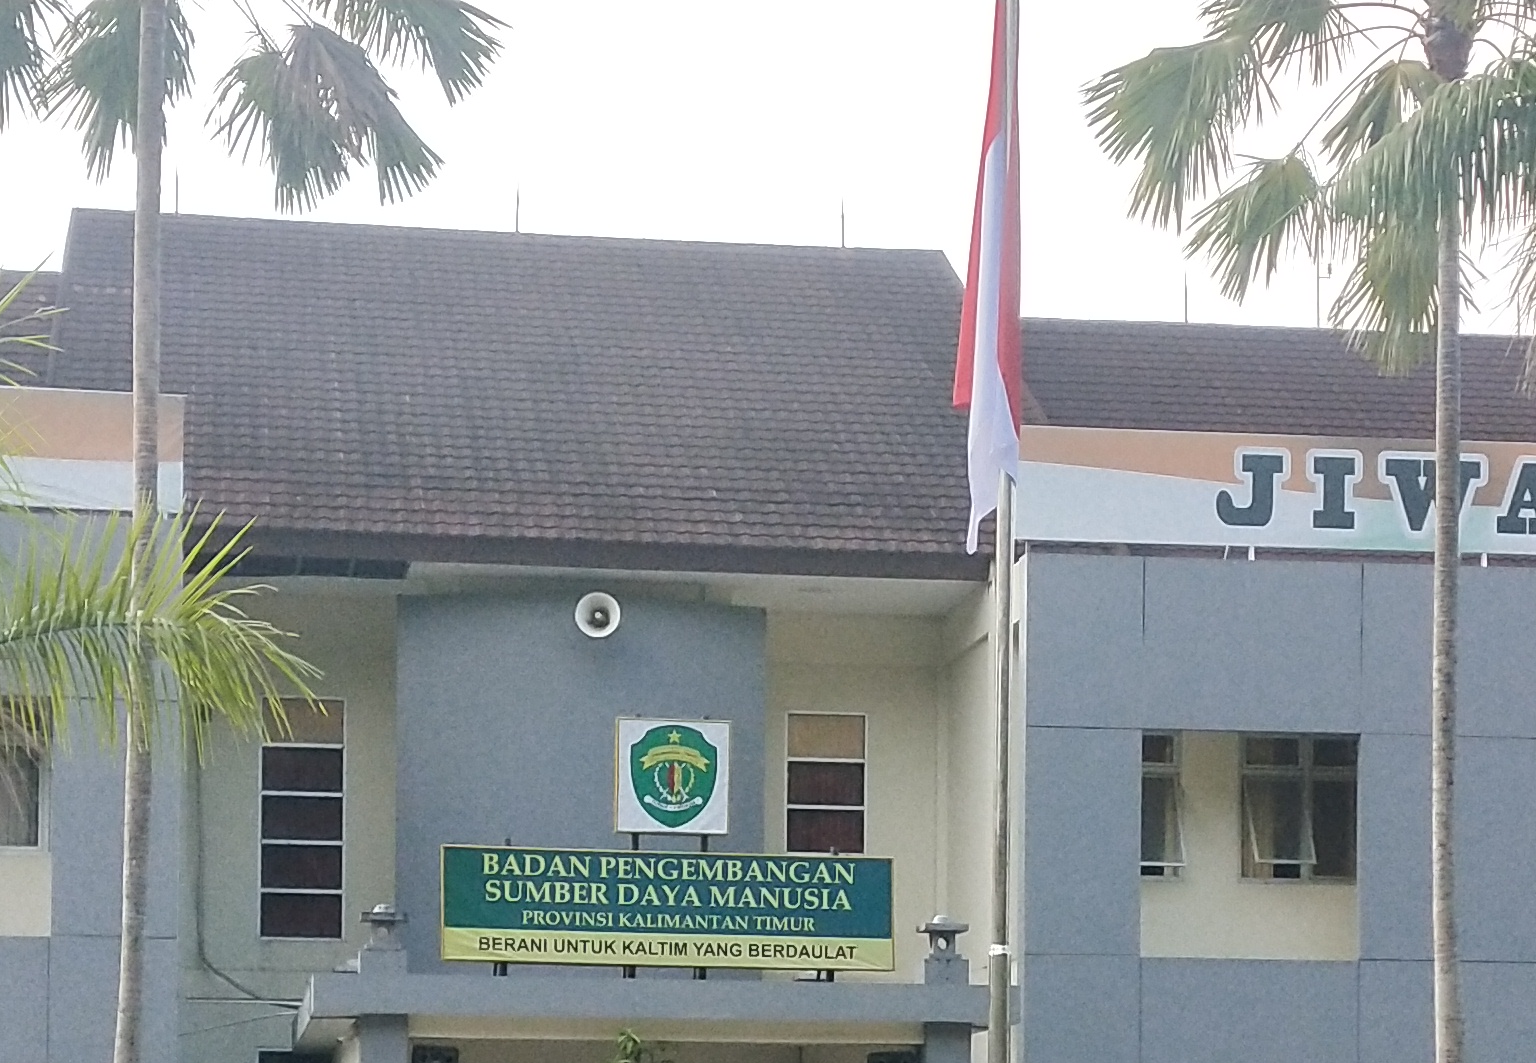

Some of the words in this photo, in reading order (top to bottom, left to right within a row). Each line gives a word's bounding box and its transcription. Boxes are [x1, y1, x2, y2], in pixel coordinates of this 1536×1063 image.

[482, 852, 592, 878] BADAN
[599, 856, 856, 885] PENGEMBANGAN
[484, 879, 610, 905] SUMBER
[617, 883, 703, 907] DAYA
[709, 885, 853, 911] MANUSIA
[521, 909, 614, 927] PROVINSI
[619, 912, 749, 930] KALIMANTAN
[753, 915, 816, 932] TIMUR
[478, 936, 548, 953] BERANI
[553, 938, 616, 955] UNTUK
[622, 940, 688, 956] KALTIM
[692, 941, 743, 958] YANG
[748, 943, 858, 960] BERDAULAT
